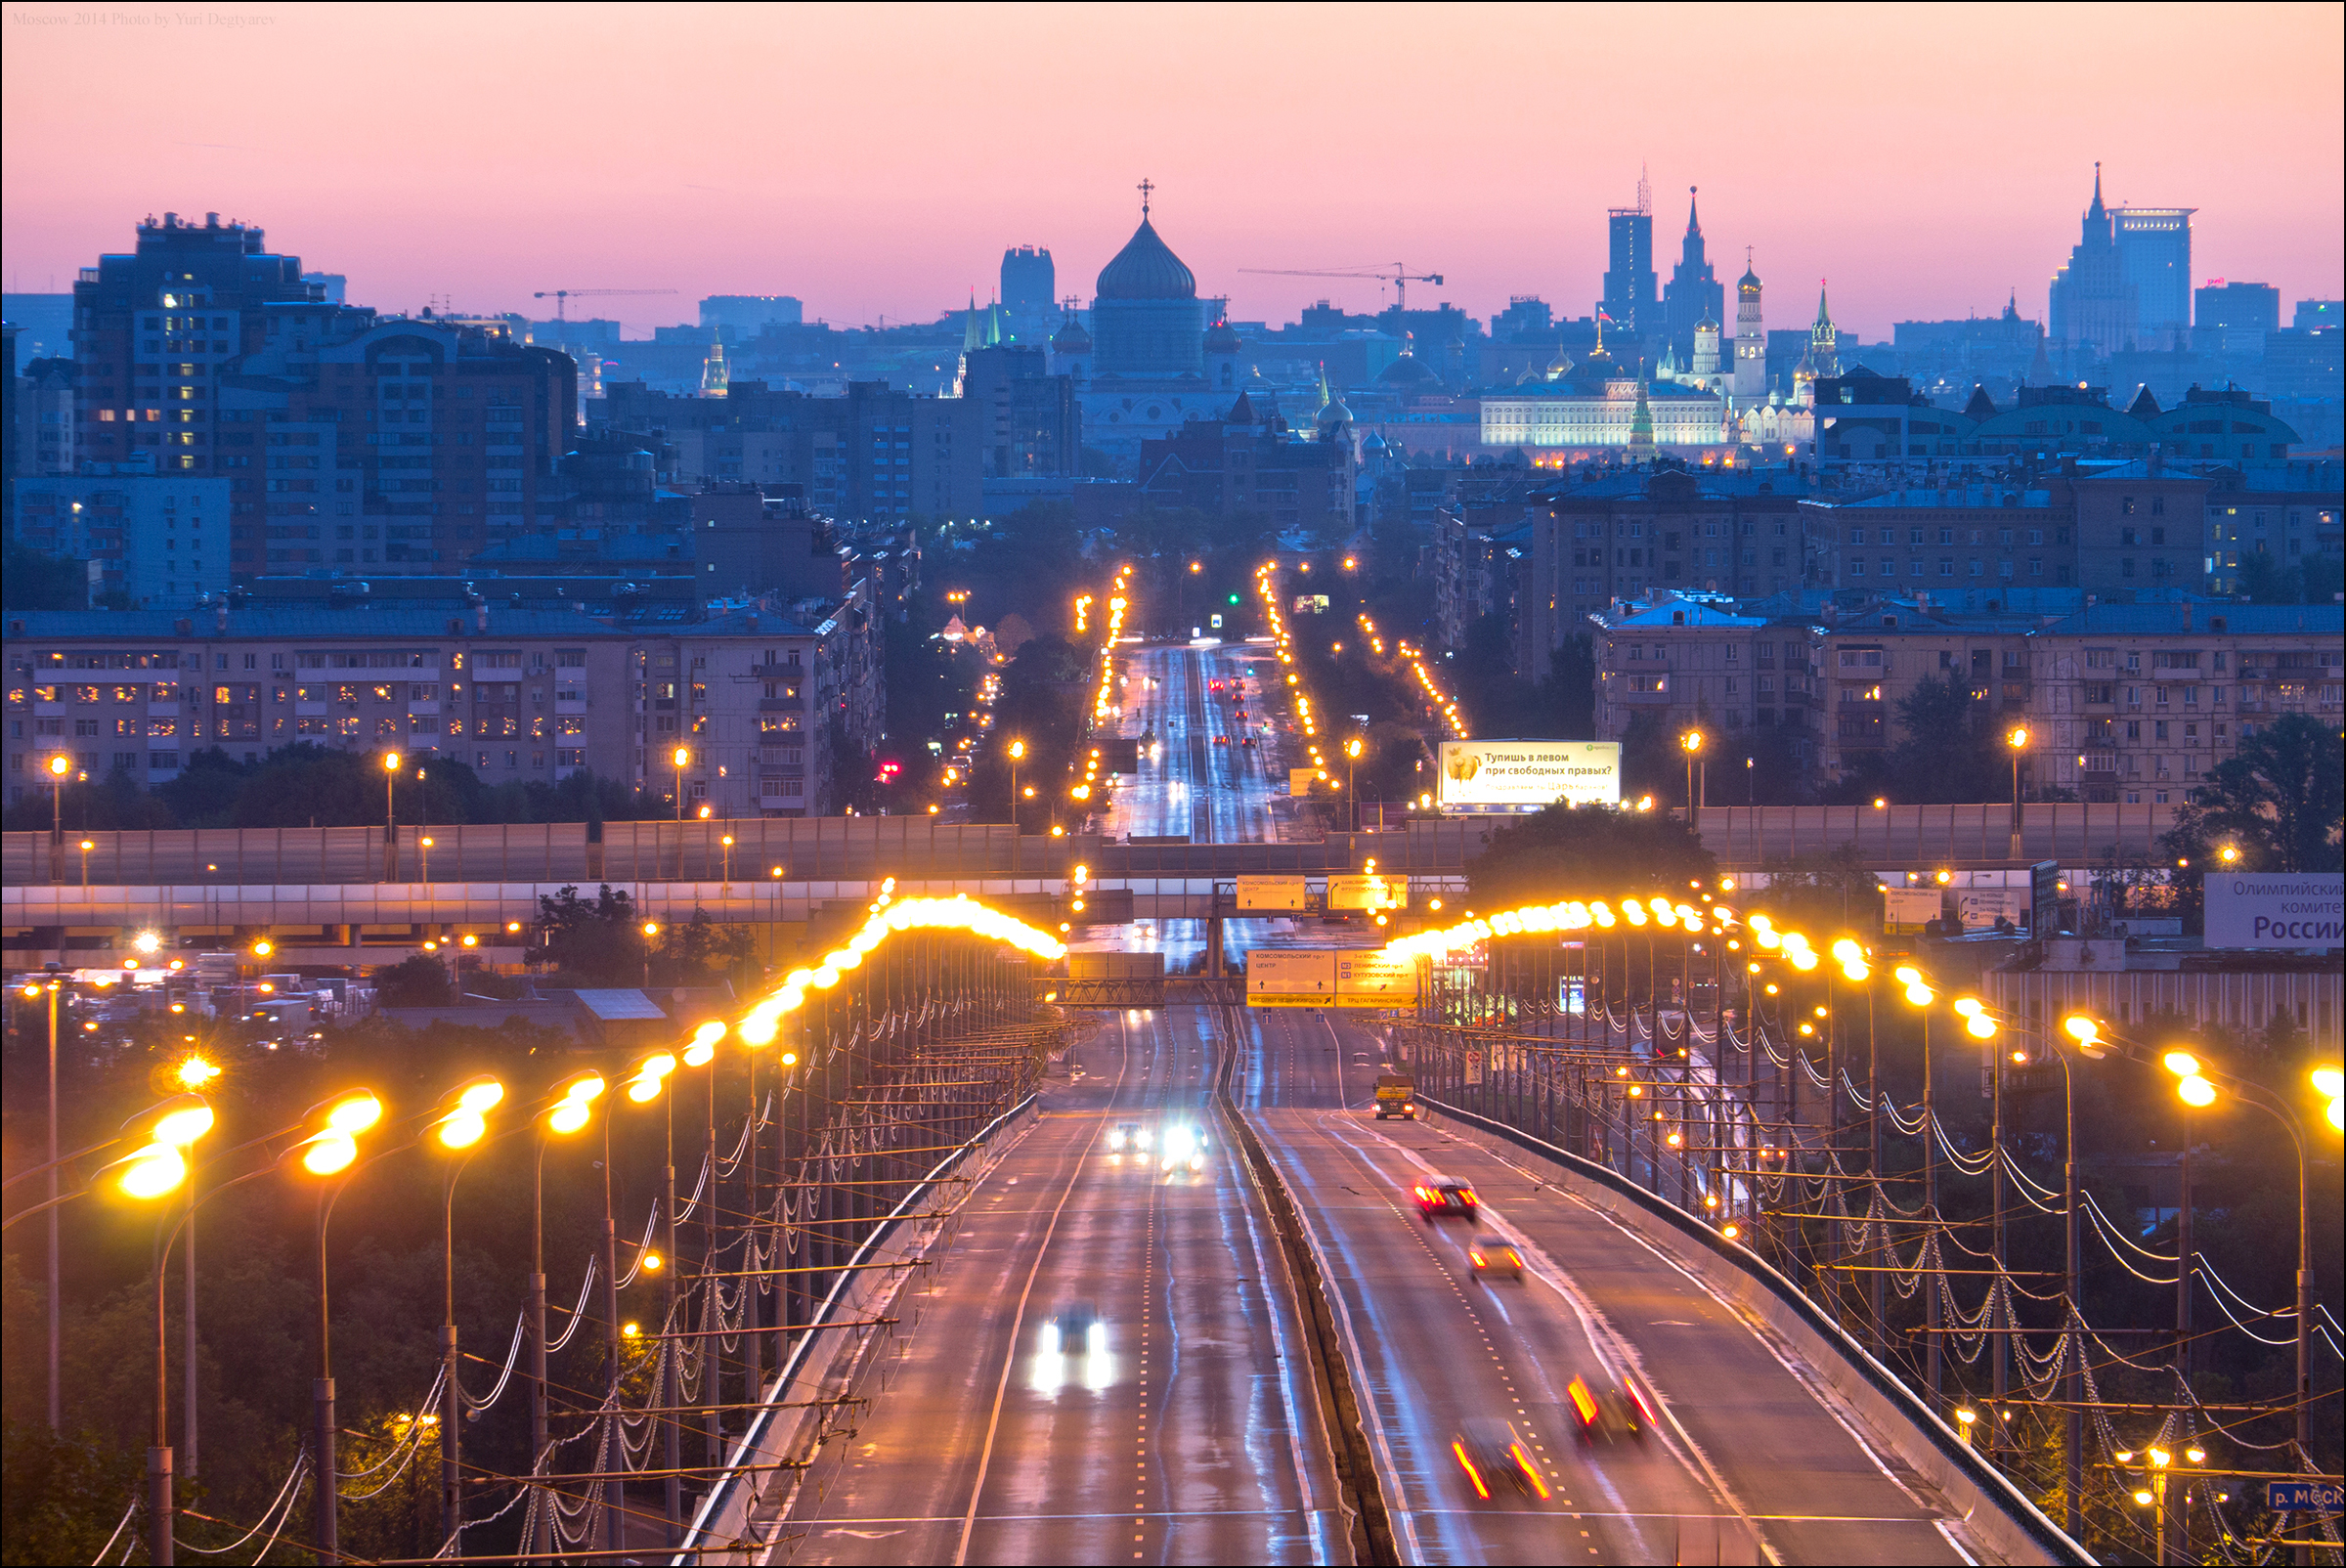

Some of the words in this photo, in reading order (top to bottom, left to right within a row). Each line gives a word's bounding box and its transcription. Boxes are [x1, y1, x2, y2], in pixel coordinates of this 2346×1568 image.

[1485, 753, 1526, 763] Тупишь
[1485, 767, 1505, 776] при
[1508, 765, 1565, 776] свободных
[1567, 765, 1612, 777] правых?
[2254, 916, 2344, 938] России
[2275, 1492, 2288, 1507] р.
